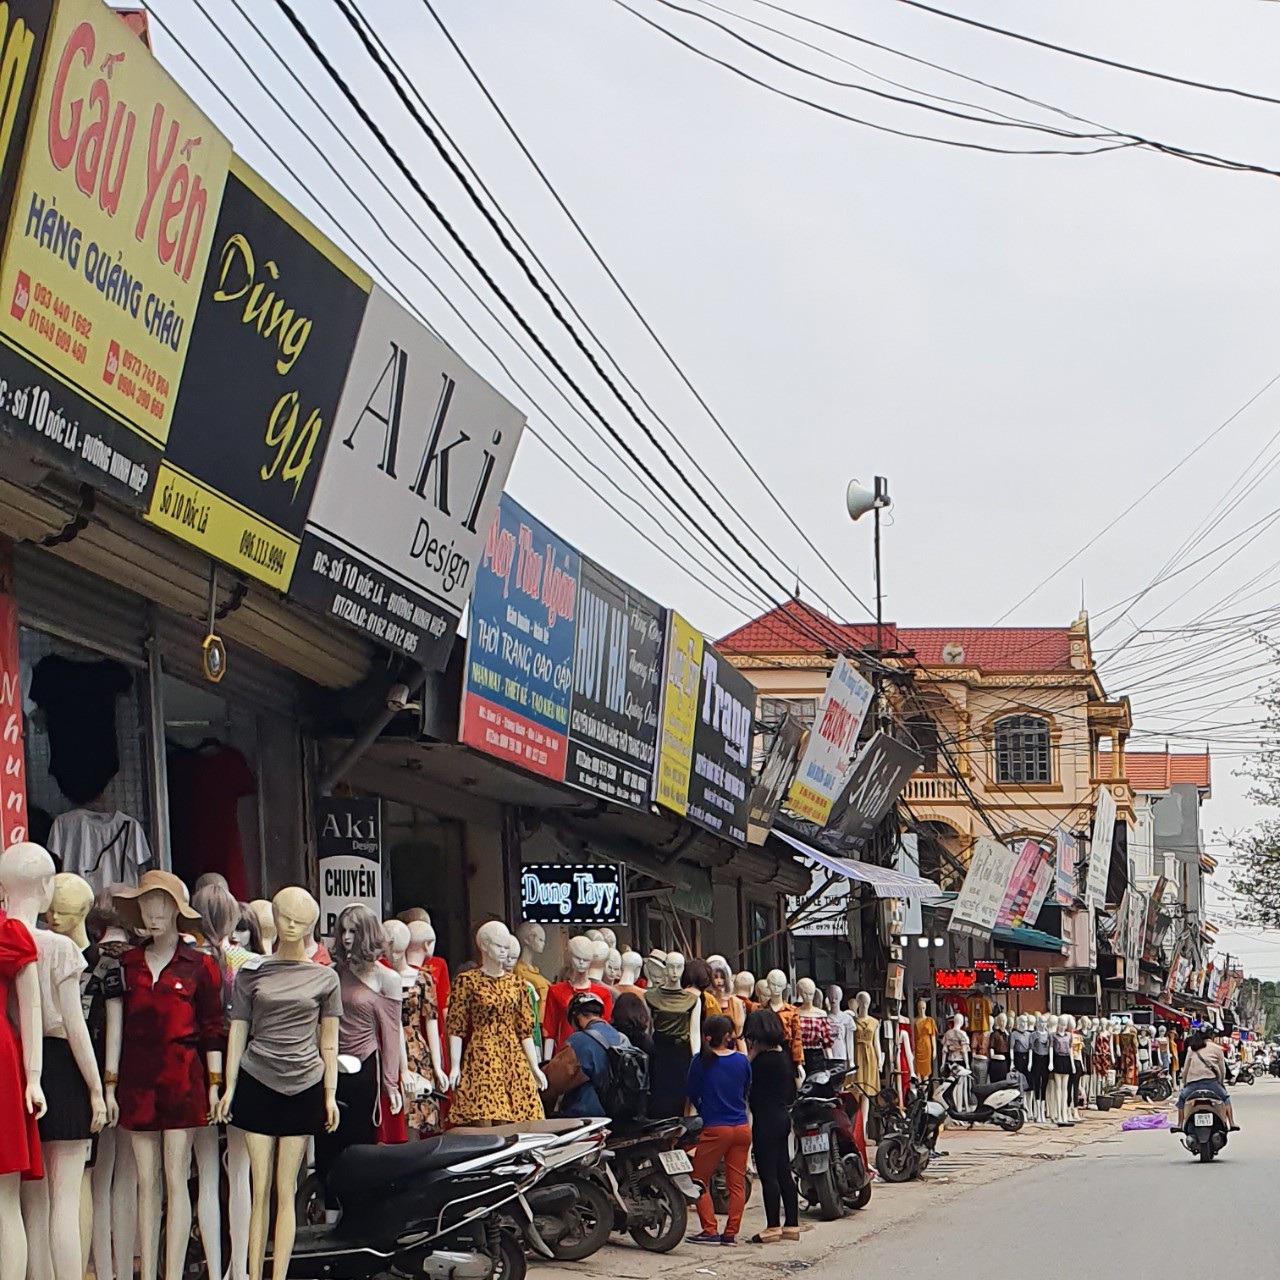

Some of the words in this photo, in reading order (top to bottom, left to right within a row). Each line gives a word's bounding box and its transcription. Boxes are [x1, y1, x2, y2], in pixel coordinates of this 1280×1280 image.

[48, 22, 136, 218] Gấu
[135, 102, 207, 284] Yến
[25, 191, 83, 271] HÀNG
[84, 241, 144, 320] QUẢNG
[144, 292, 185, 353] CHÂU
[28, 386, 50, 431] 10
[342, 340, 502, 535] Aki
[343, 563, 358, 590] 10
[409, 517, 470, 593] Design
[479, 616, 500, 655] THỜI
[502, 632, 531, 676] TRANG
[533, 652, 552, 682] CAO
[553, 656, 571, 694] CẤP
[574, 587, 609, 702] HUY
[703, 650, 750, 769] Trang
[322, 813, 376, 838] Aki
[352, 840, 378, 853] Design
[325, 864, 376, 898] CHUYÊN
[523, 873, 572, 914] Dung
